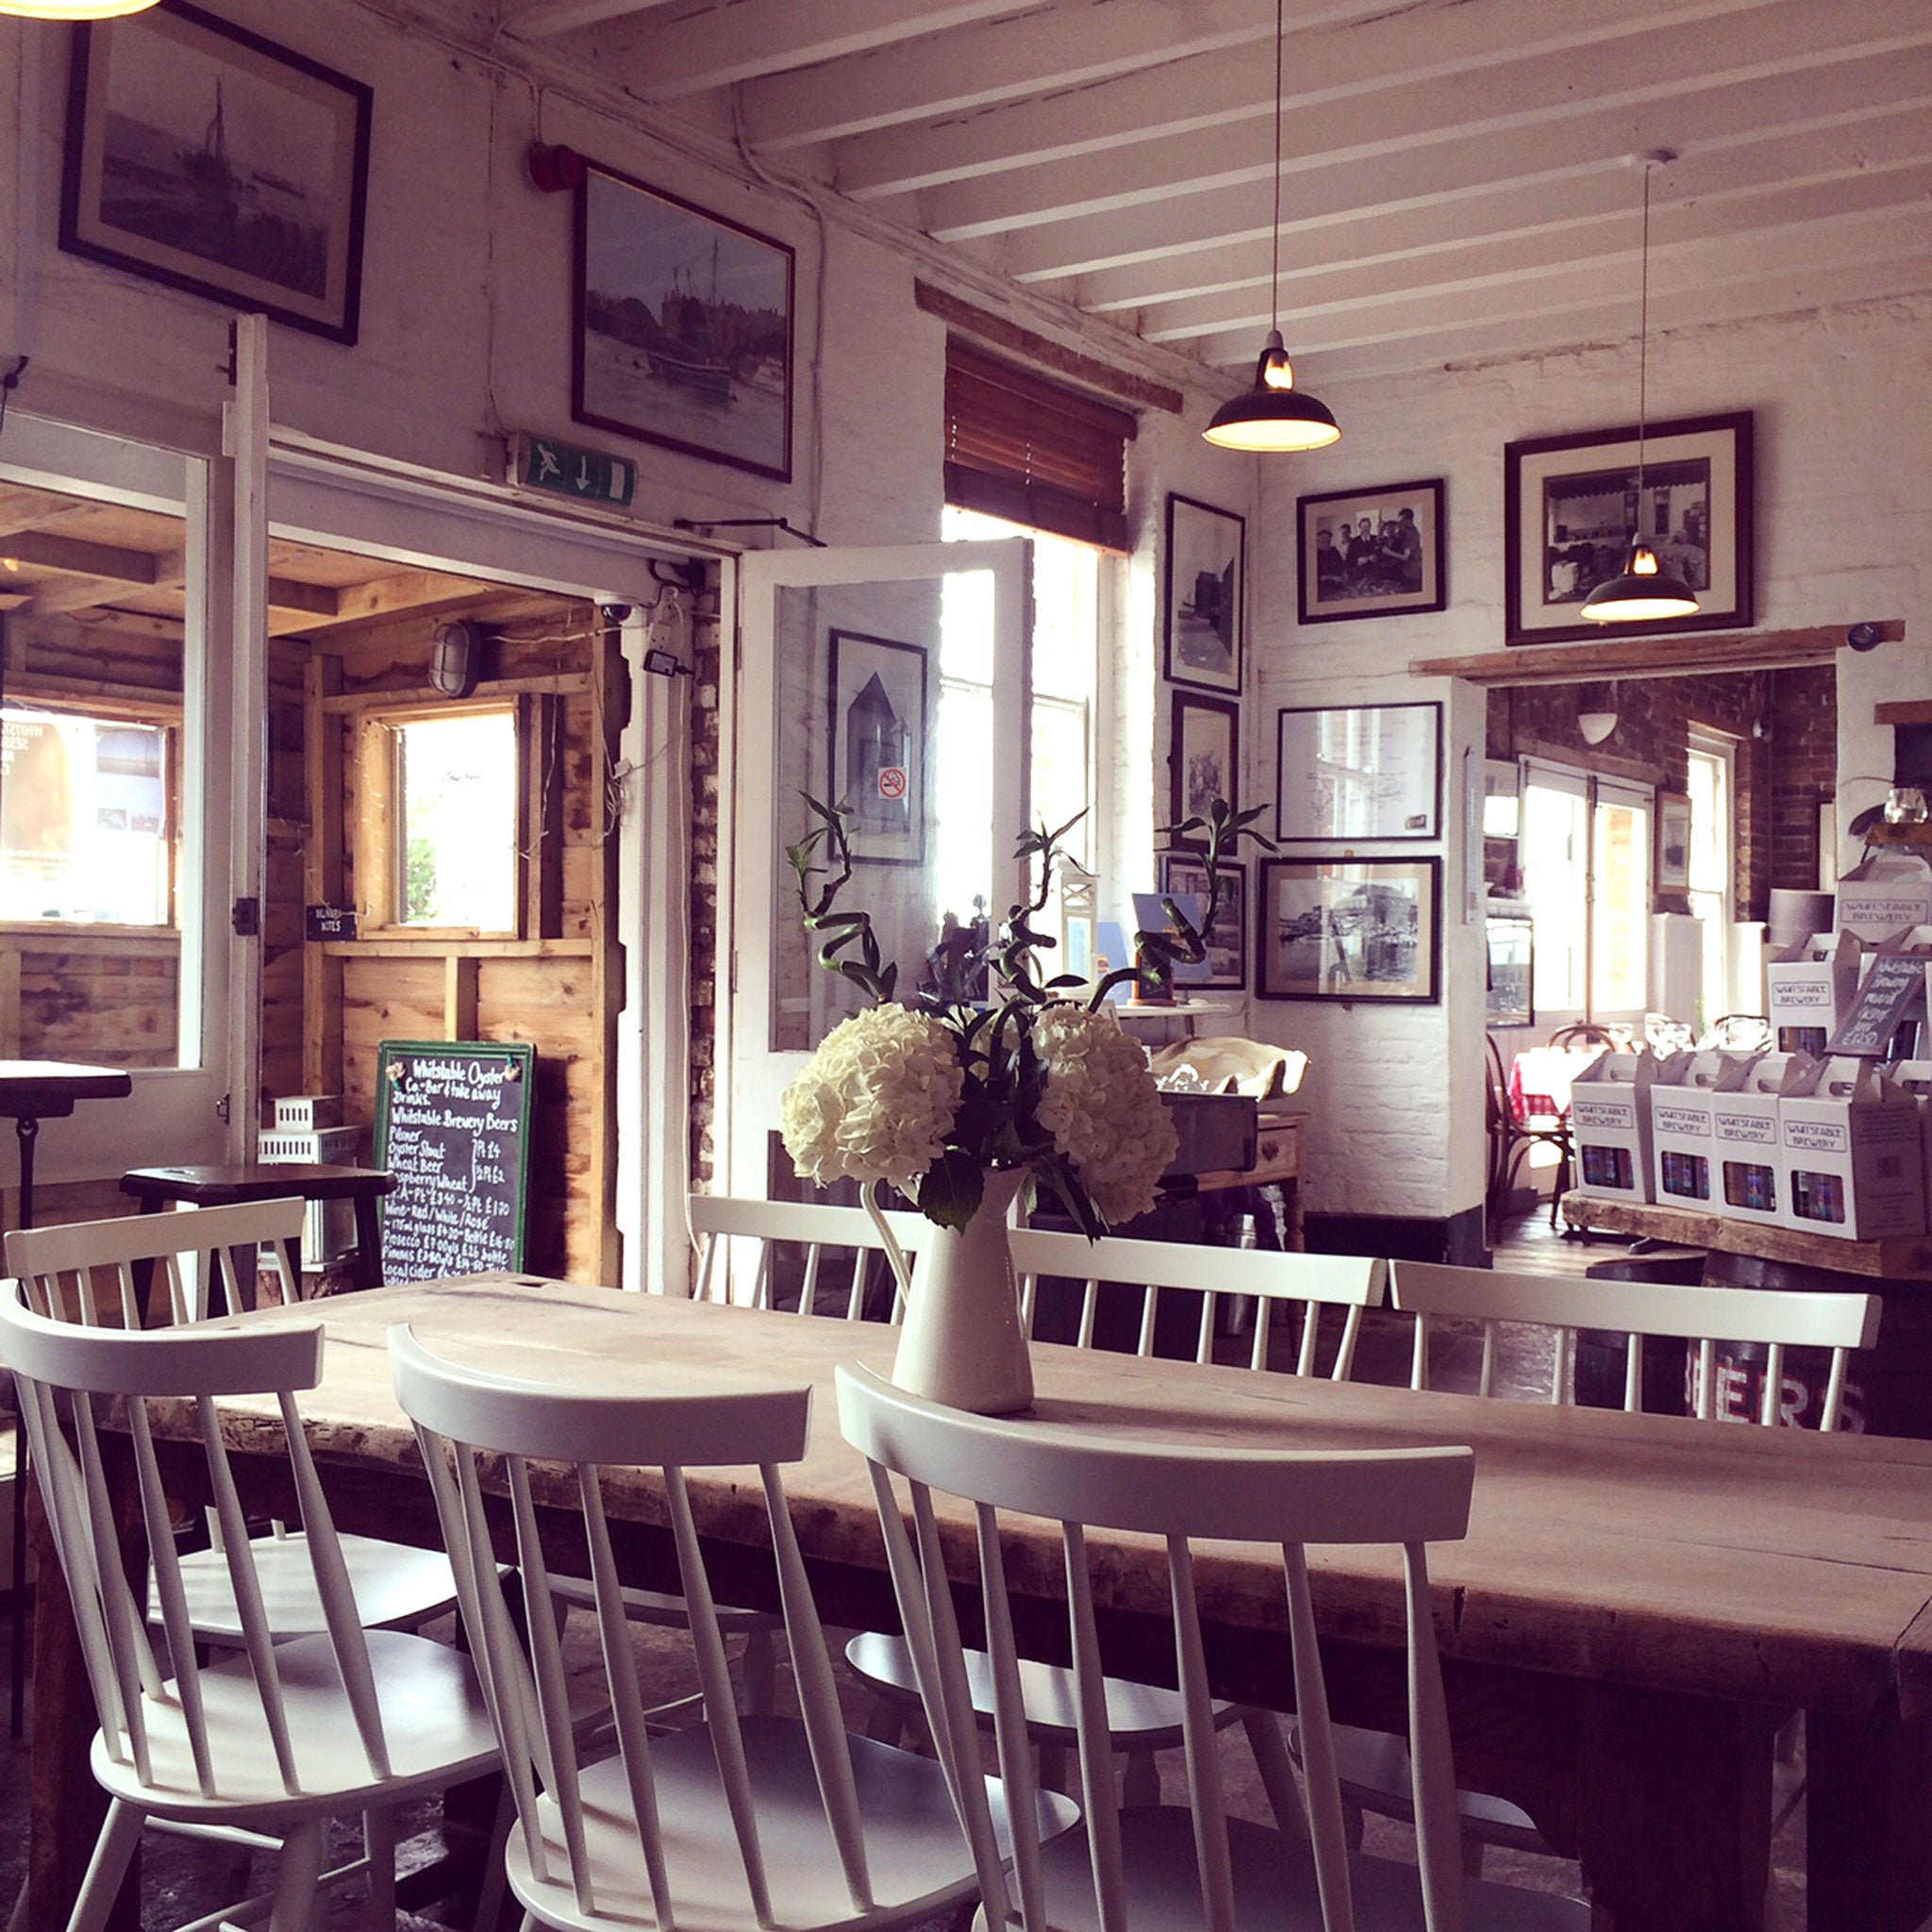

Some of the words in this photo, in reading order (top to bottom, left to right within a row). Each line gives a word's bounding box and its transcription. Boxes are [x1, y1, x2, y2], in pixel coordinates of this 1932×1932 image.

[412, 1058, 467, 1081] Whitstable
[468, 1060, 507, 1090] Oyster
[472, 1087, 502, 1111] away
[391, 1106, 441, 1126] Whitstable
[442, 1108, 485, 1138] Brewery
[486, 1112, 519, 1133] Beers
[1787, 1124, 1842, 1138] WHITSTABLE
[1791, 1136, 1837, 1148] BREWERY
[420, 1158, 444, 1174] Beer
[382, 1260, 408, 1280] Local
